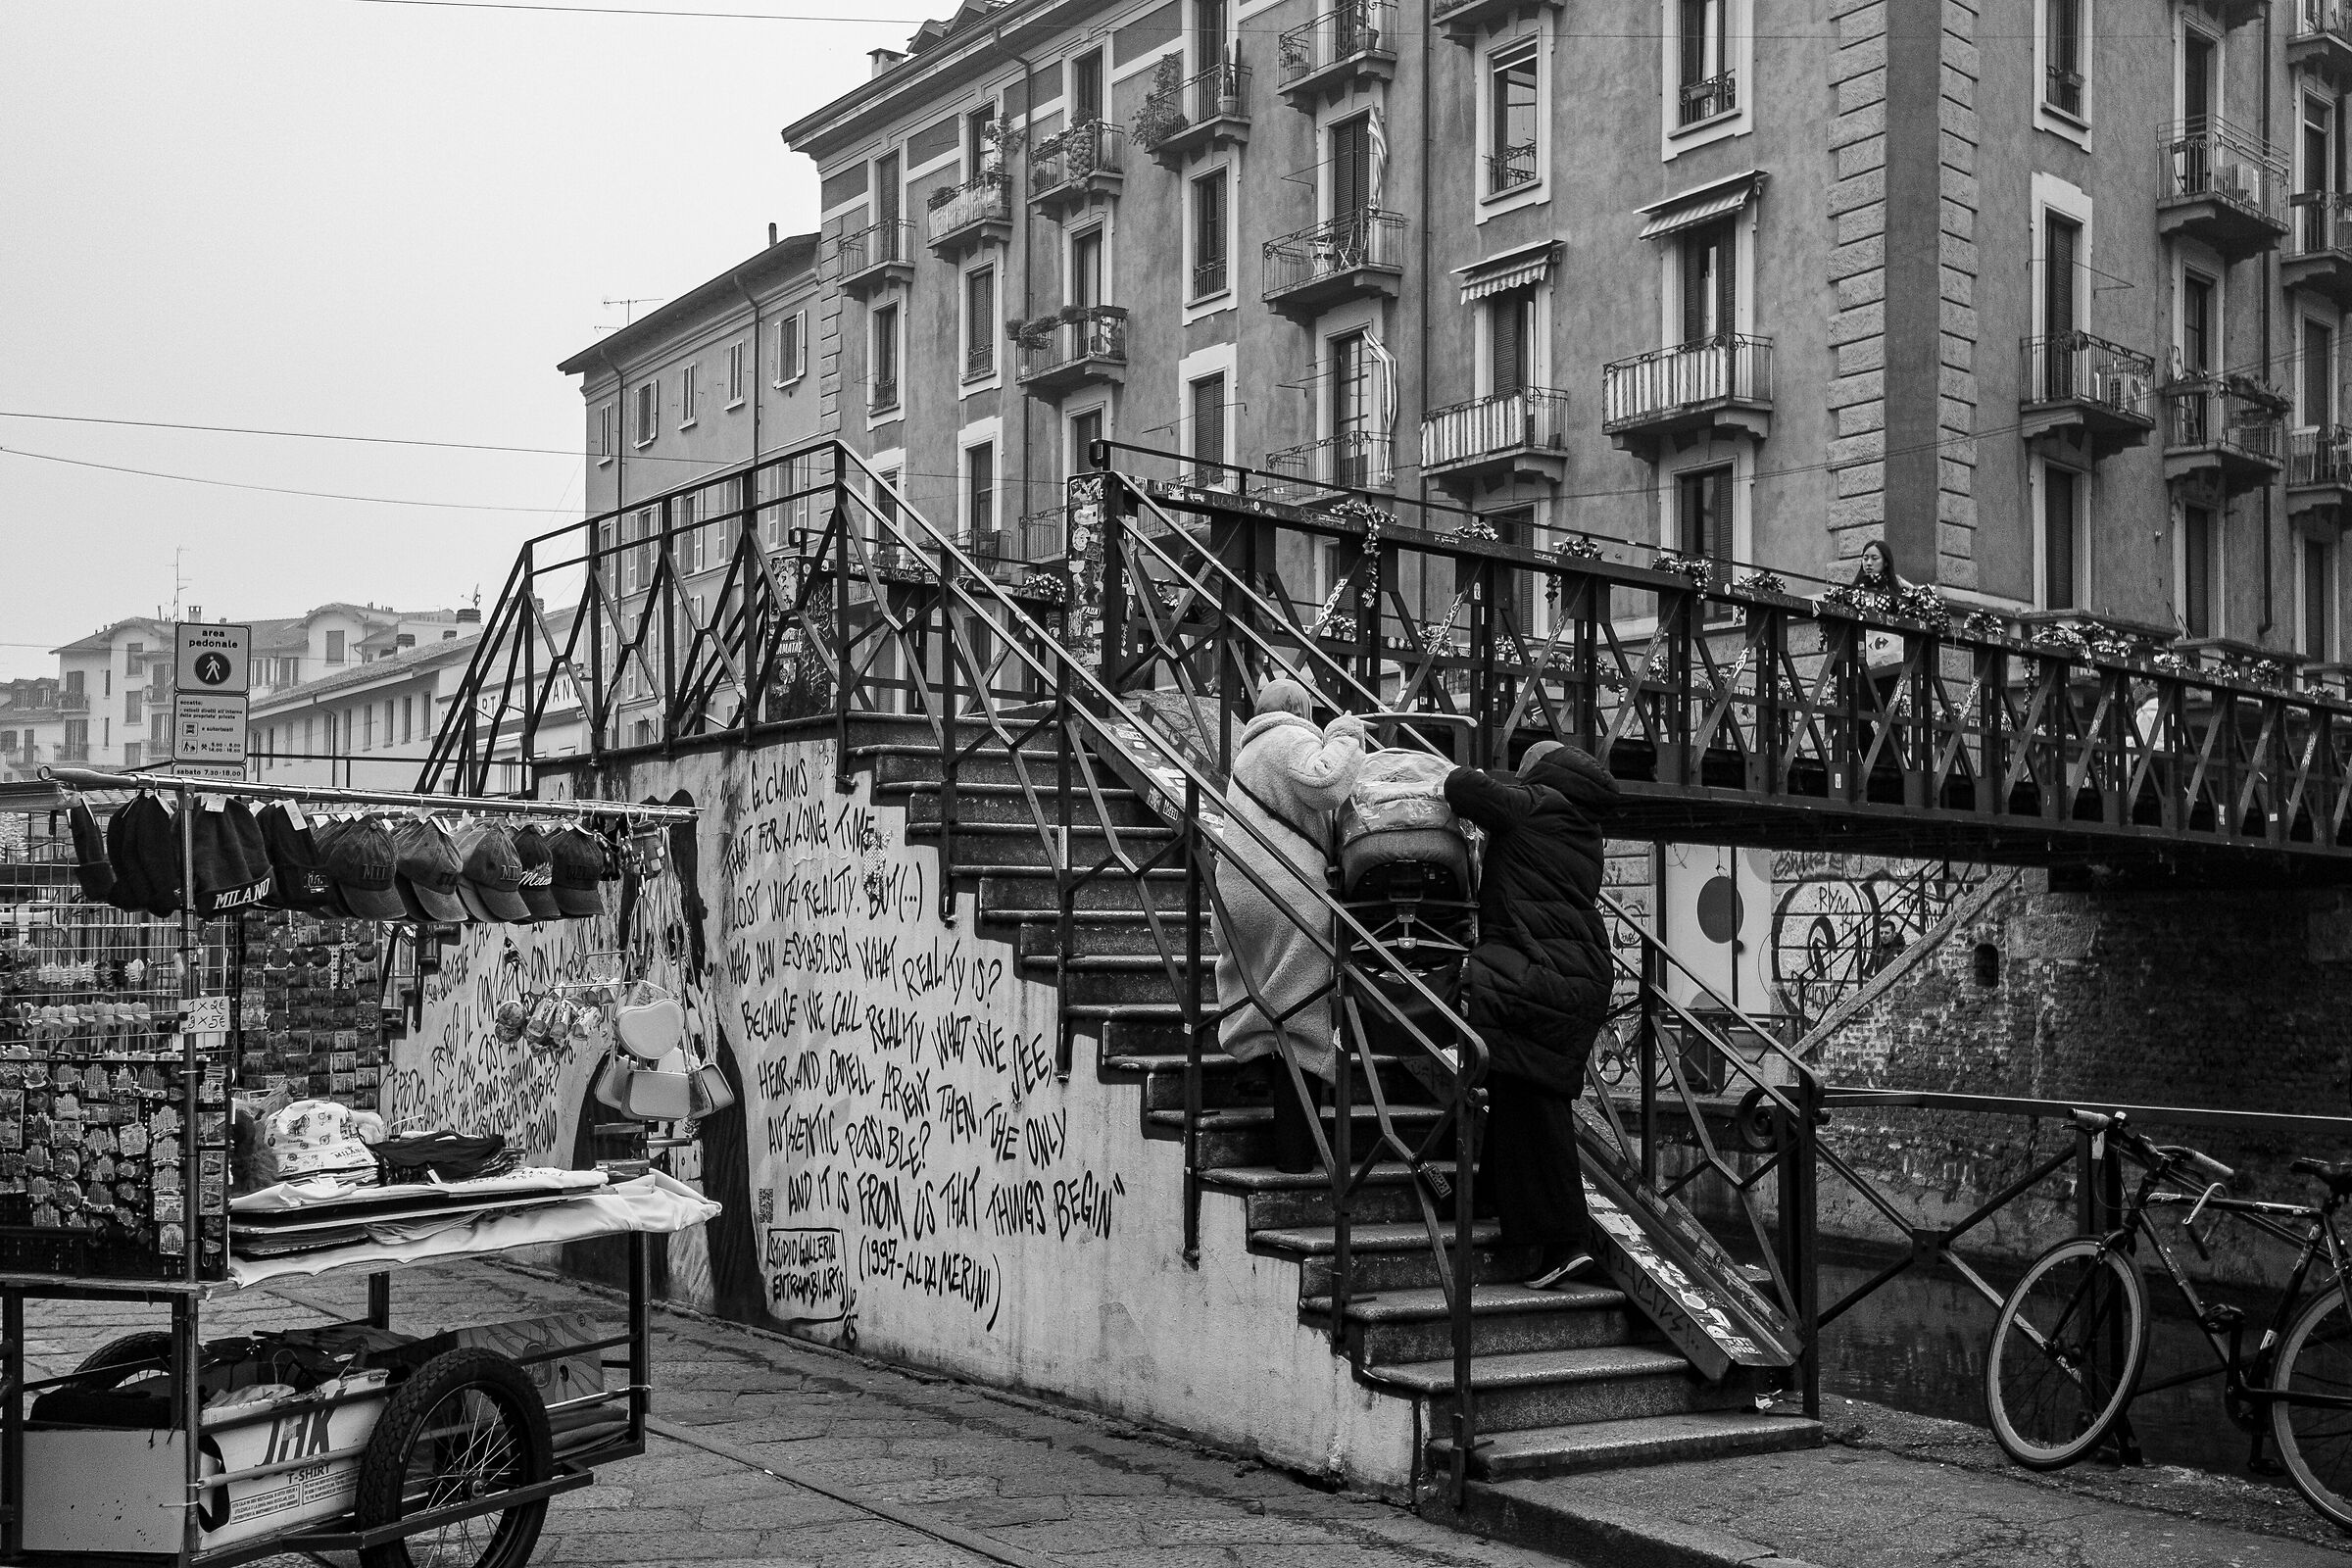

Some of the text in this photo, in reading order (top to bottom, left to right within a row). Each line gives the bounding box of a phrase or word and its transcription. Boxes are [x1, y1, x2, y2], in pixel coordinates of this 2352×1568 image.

[188, 639, 238, 649] pedonale
[721, 800, 875, 886] THAT FOR A LONG TIME
[213, 877, 270, 910] MILANO
[733, 878, 760, 932] LOST
[726, 926, 1003, 1010] WHO CAN ESTABLISH WHAT REALITY IS?
[208, 1015, 225, 1029] 5€
[741, 987, 798, 1042] BECAUSE
[803, 989, 825, 1034] WE
[831, 990, 862, 1037] CALL
[865, 1004, 925, 1064] REALITY
[931, 1011, 972, 1070] WHAT
[972, 1018, 1006, 1074] WE
[768, 1103, 931, 1180] AUTHENTIC POSSIBLE?
[825, 1049, 875, 1098] SMELL.
[983, 1102, 1020, 1163] THE
[1025, 1106, 1066, 1171] ONLY
[789, 1170, 812, 1217] AND
[817, 1164, 831, 1211] IT
[837, 1170, 850, 1214] IS
[857, 1171, 907, 1241] FROM
[913, 1180, 936, 1242] US
[940, 1165, 981, 1232] THAT
[986, 1180, 1047, 1237] THINGS
[768, 1236, 798, 1270] STUDIO
[286, 1464, 330, 1485] T-SHIRT
